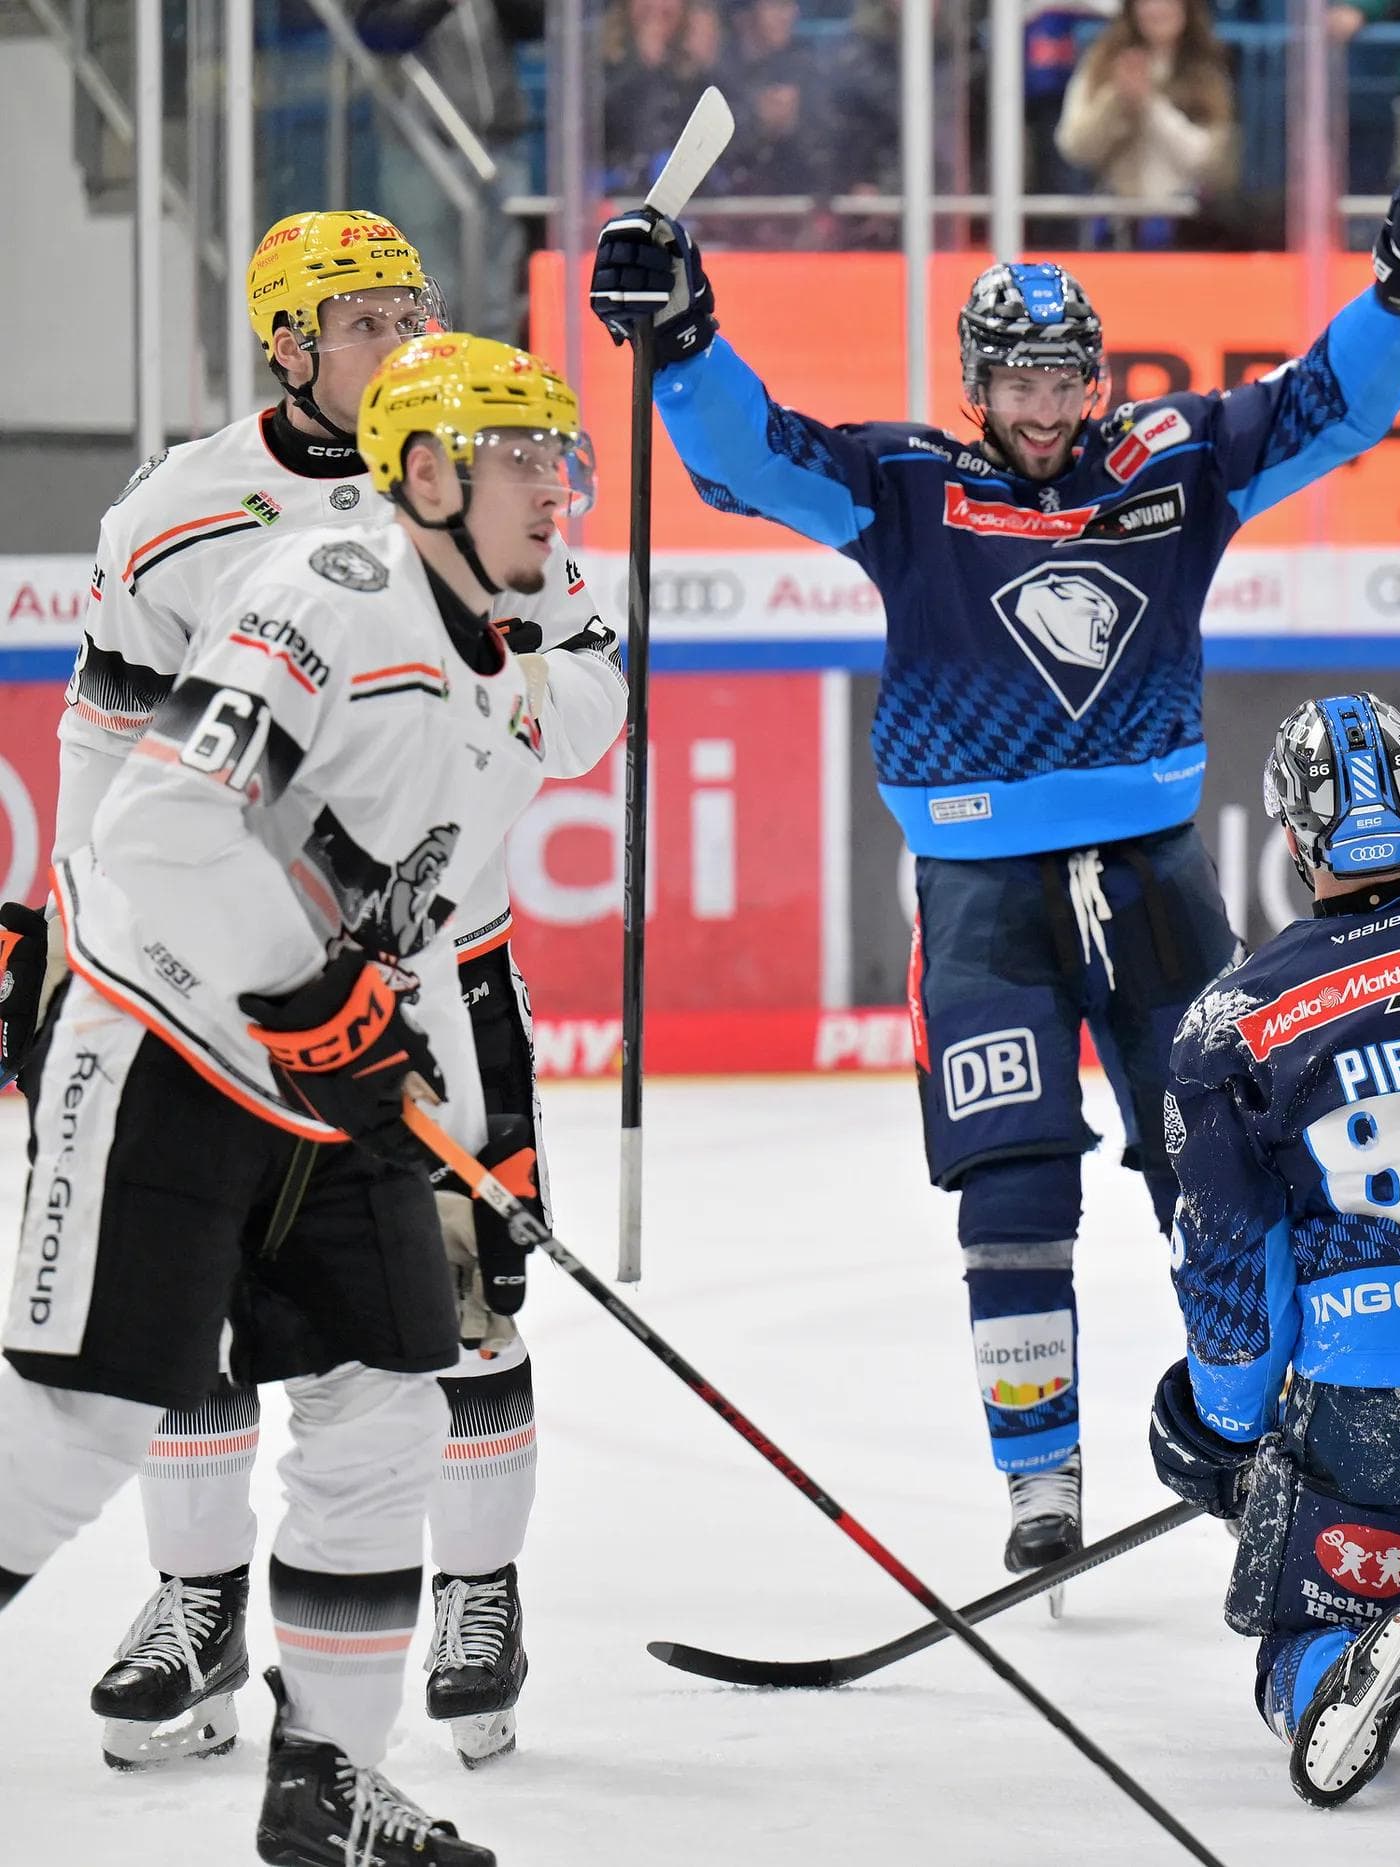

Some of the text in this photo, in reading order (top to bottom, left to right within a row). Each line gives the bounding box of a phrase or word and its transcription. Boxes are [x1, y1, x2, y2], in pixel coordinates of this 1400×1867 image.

[257, 226, 302, 255] LOTTO
[370, 249, 411, 259] CCM
[252, 276, 286, 299] CCM
[956, 451, 1001, 477] Bay
[246, 493, 278, 521] FFH
[1119, 501, 1175, 532] SATURN
[7, 580, 88, 623] Au
[767, 578, 882, 613] Aud
[179, 688, 271, 792] 61
[1309, 763, 1330, 777] 86
[1356, 817, 1383, 827] ERC
[813, 1010, 913, 1070] PE
[950, 1040, 1029, 1107] DB
[1351, 1670, 1379, 1706] BAUER
